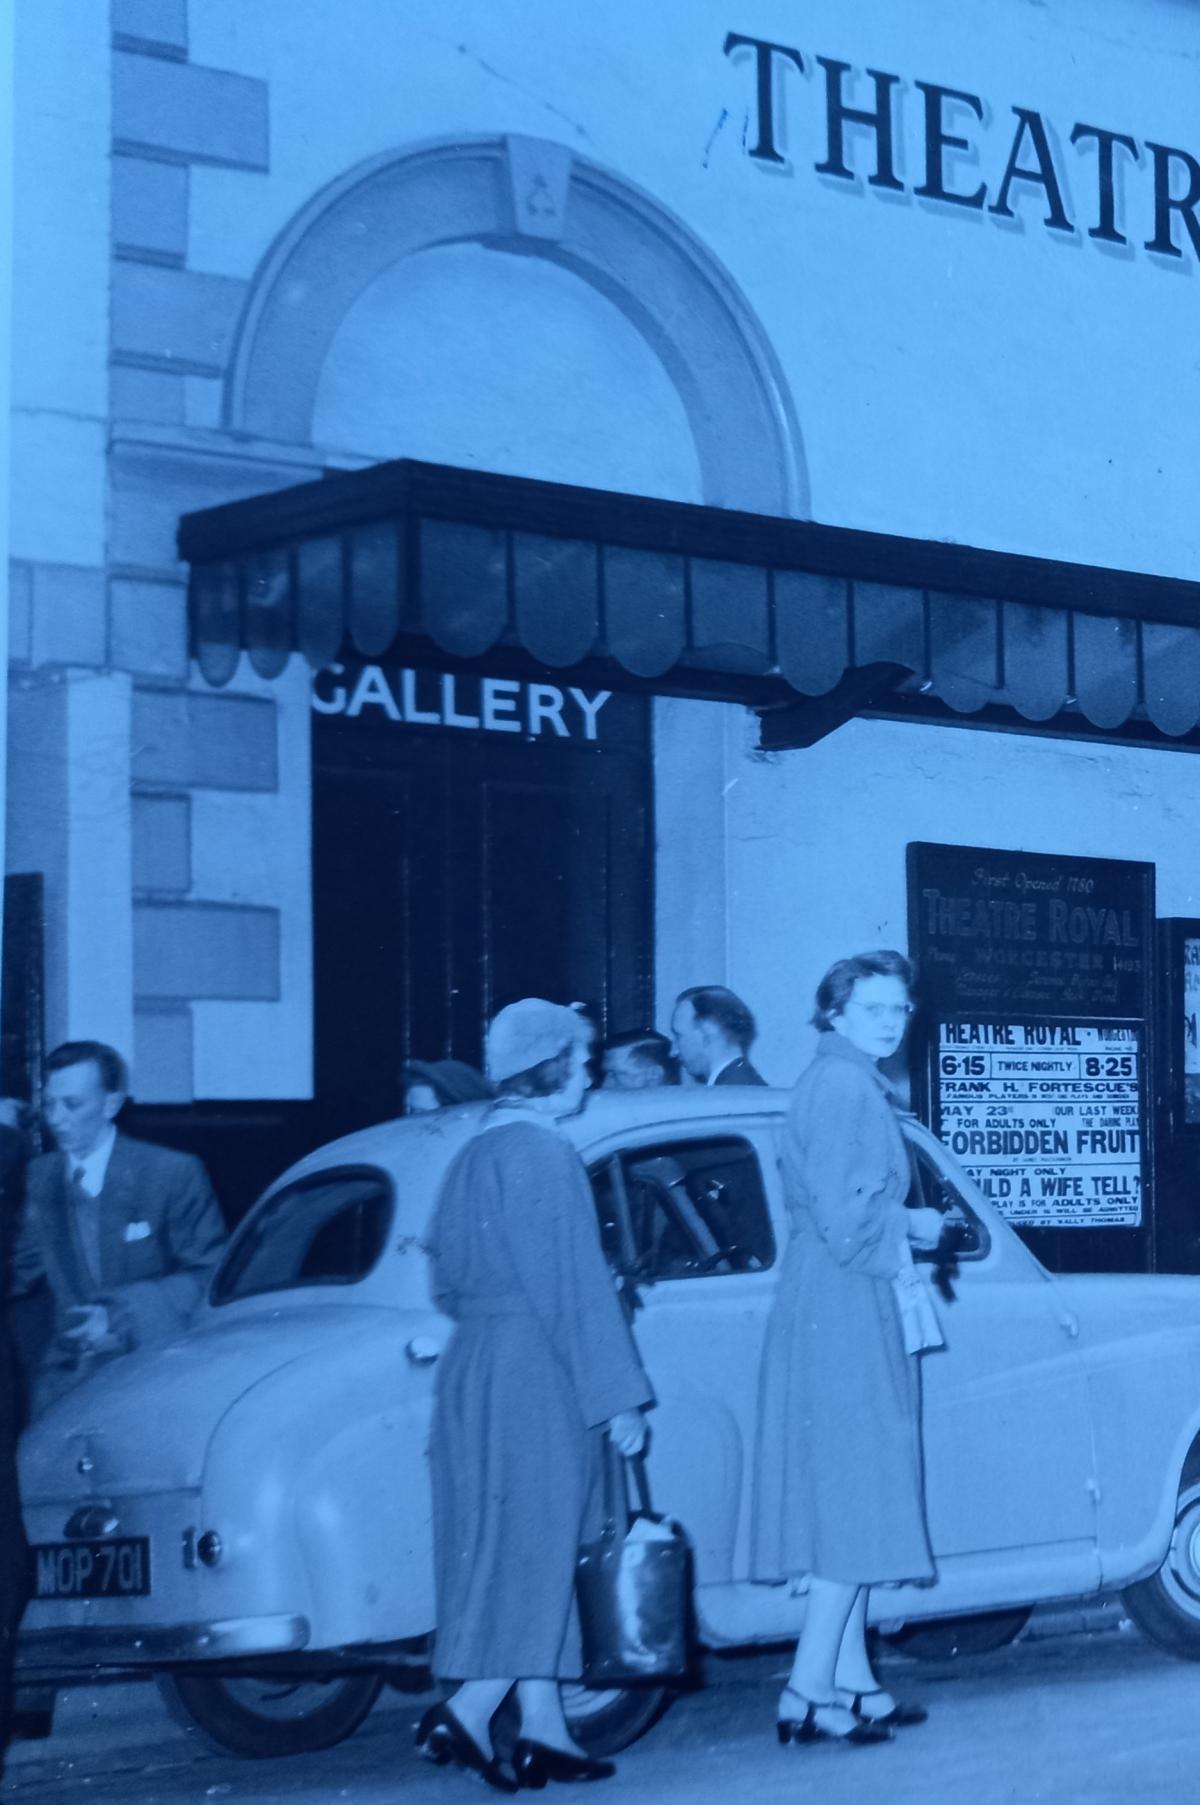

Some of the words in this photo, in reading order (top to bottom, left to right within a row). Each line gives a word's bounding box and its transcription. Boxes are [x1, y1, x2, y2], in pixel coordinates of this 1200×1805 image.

[311, 662, 612, 740] GALLERY
[922, 888, 1037, 941] THEATRE
[1049, 898, 1140, 947] ROYAL
[945, 1023, 1016, 1045] HEATRE
[1024, 1025, 1082, 1046] ROYAL
[997, 1060, 1029, 1072] TWICE
[1031, 1060, 1073, 1072] NIGHTLY
[1055, 1105, 1074, 1116] OUR
[1079, 1105, 1107, 1116] LAST
[957, 1118, 979, 1129] FOR
[985, 1118, 1025, 1129] ADULTS
[1029, 1118, 1056, 1129] ONLY
[1076, 1129, 1140, 1154] FRUIT
[989, 1167, 1027, 1176] NIGHT
[1034, 1167, 1067, 1176] ONLY
[1020, 1177, 1032, 1197] A
[1041, 1177, 1084, 1197] WIFE
[1052, 1198, 1101, 1208] ADULTS
[1106, 1196, 1138, 1205] ONLY
[37, 1548, 92, 1596] MOP
[101, 1543, 143, 1593] 701
